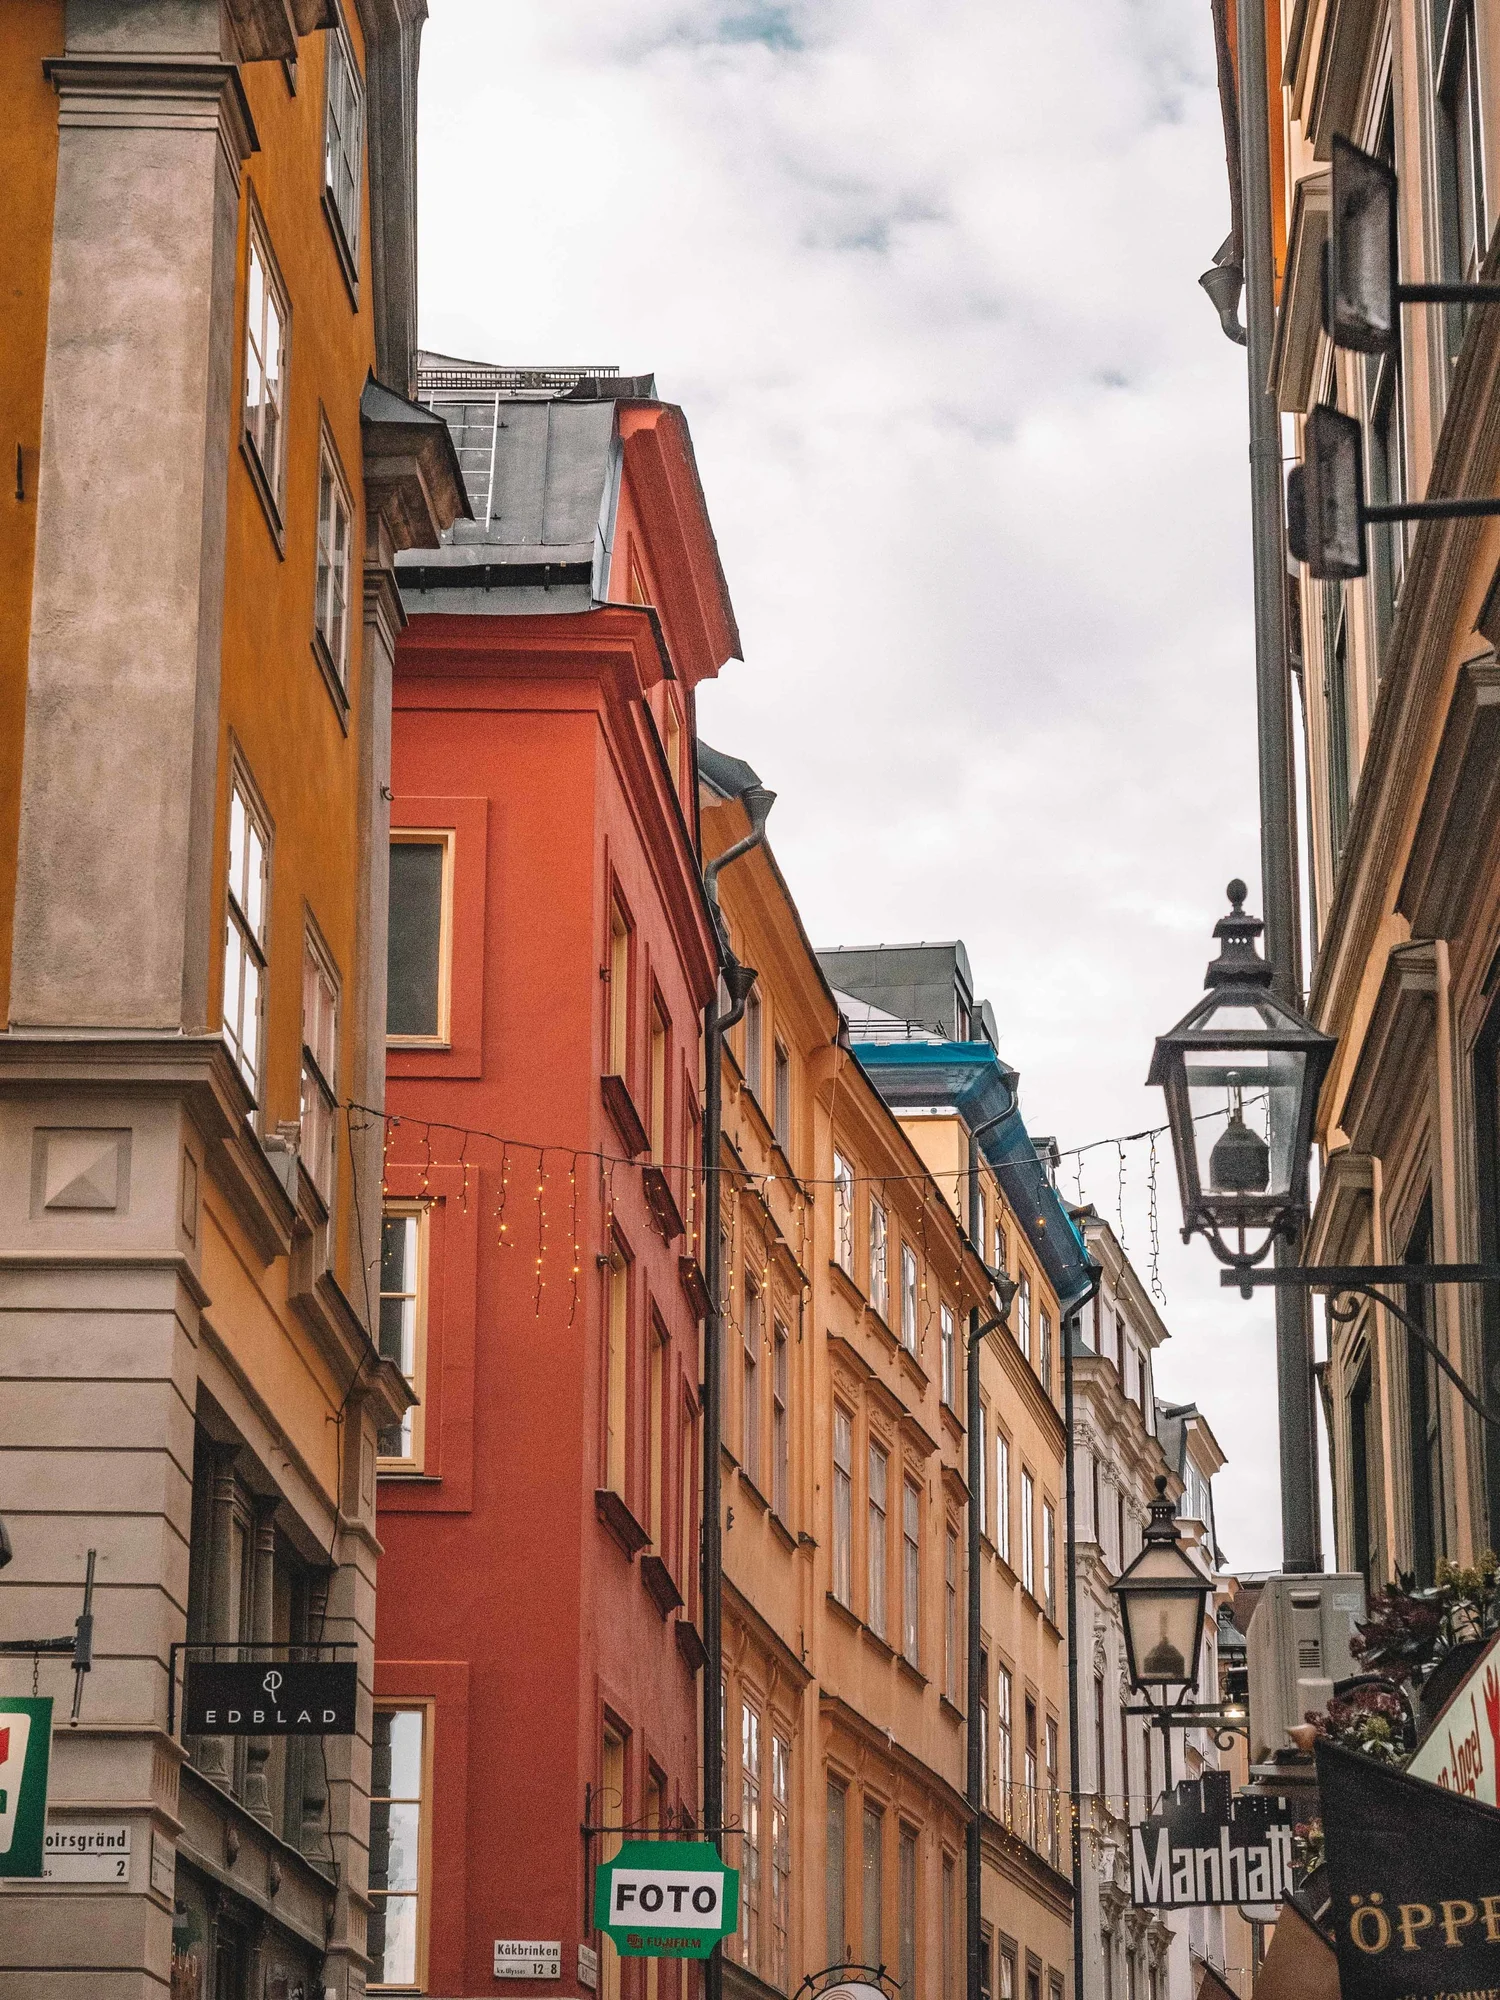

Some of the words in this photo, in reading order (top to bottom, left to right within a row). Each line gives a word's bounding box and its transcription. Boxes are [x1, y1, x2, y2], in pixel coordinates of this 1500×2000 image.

[205, 1710, 337, 1723] EDBLAD
[45, 1830, 126, 1851] oirsgränd
[116, 1860, 125, 1877] 2
[1132, 1825, 1294, 1904] Manhatt
[616, 1884, 717, 1914] FOTO
[1350, 1892, 1500, 1954] ÖPPE
[497, 1943, 558, 1956] Kåkbrinken
[647, 1936, 701, 1948] FUJIFILM
[533, 1963, 544, 1975] 12
[550, 1963, 557, 1975] 8
